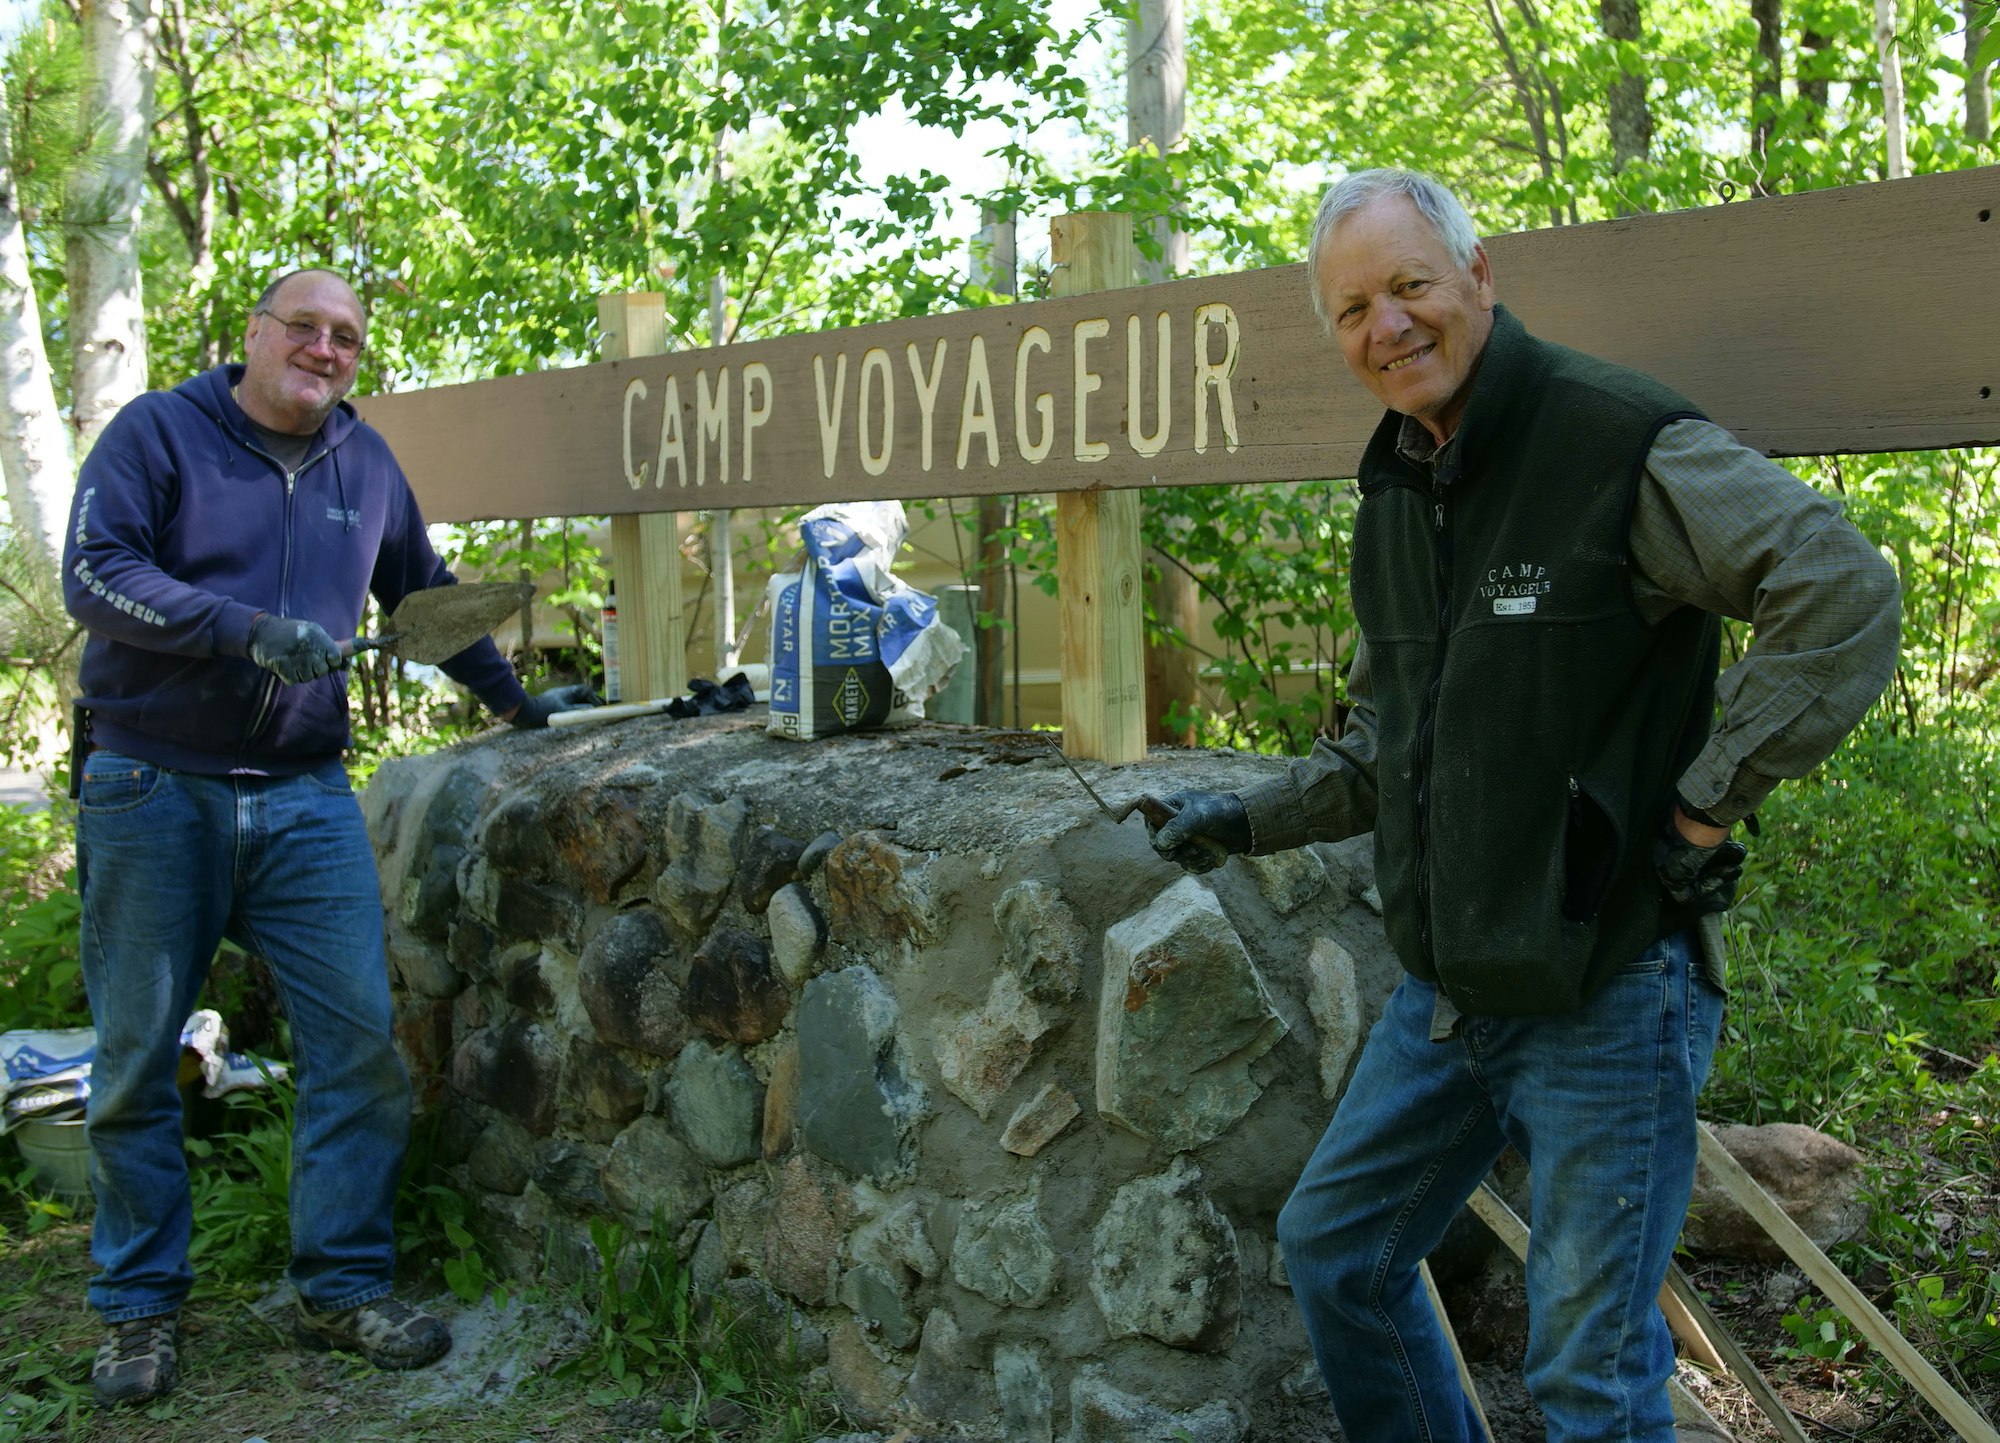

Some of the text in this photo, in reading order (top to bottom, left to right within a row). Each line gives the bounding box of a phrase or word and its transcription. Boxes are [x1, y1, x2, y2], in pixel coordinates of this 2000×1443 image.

[622, 302, 1239, 490] CAMP VOYAGEUR
[1488, 563, 1546, 582] CAMP
[1480, 581, 1551, 598] VOYAGEUR
[1495, 603, 1515, 612] Est.
[852, 606, 874, 658] MIX
[774, 678, 788, 702] N
[782, 714, 798, 739] 60
